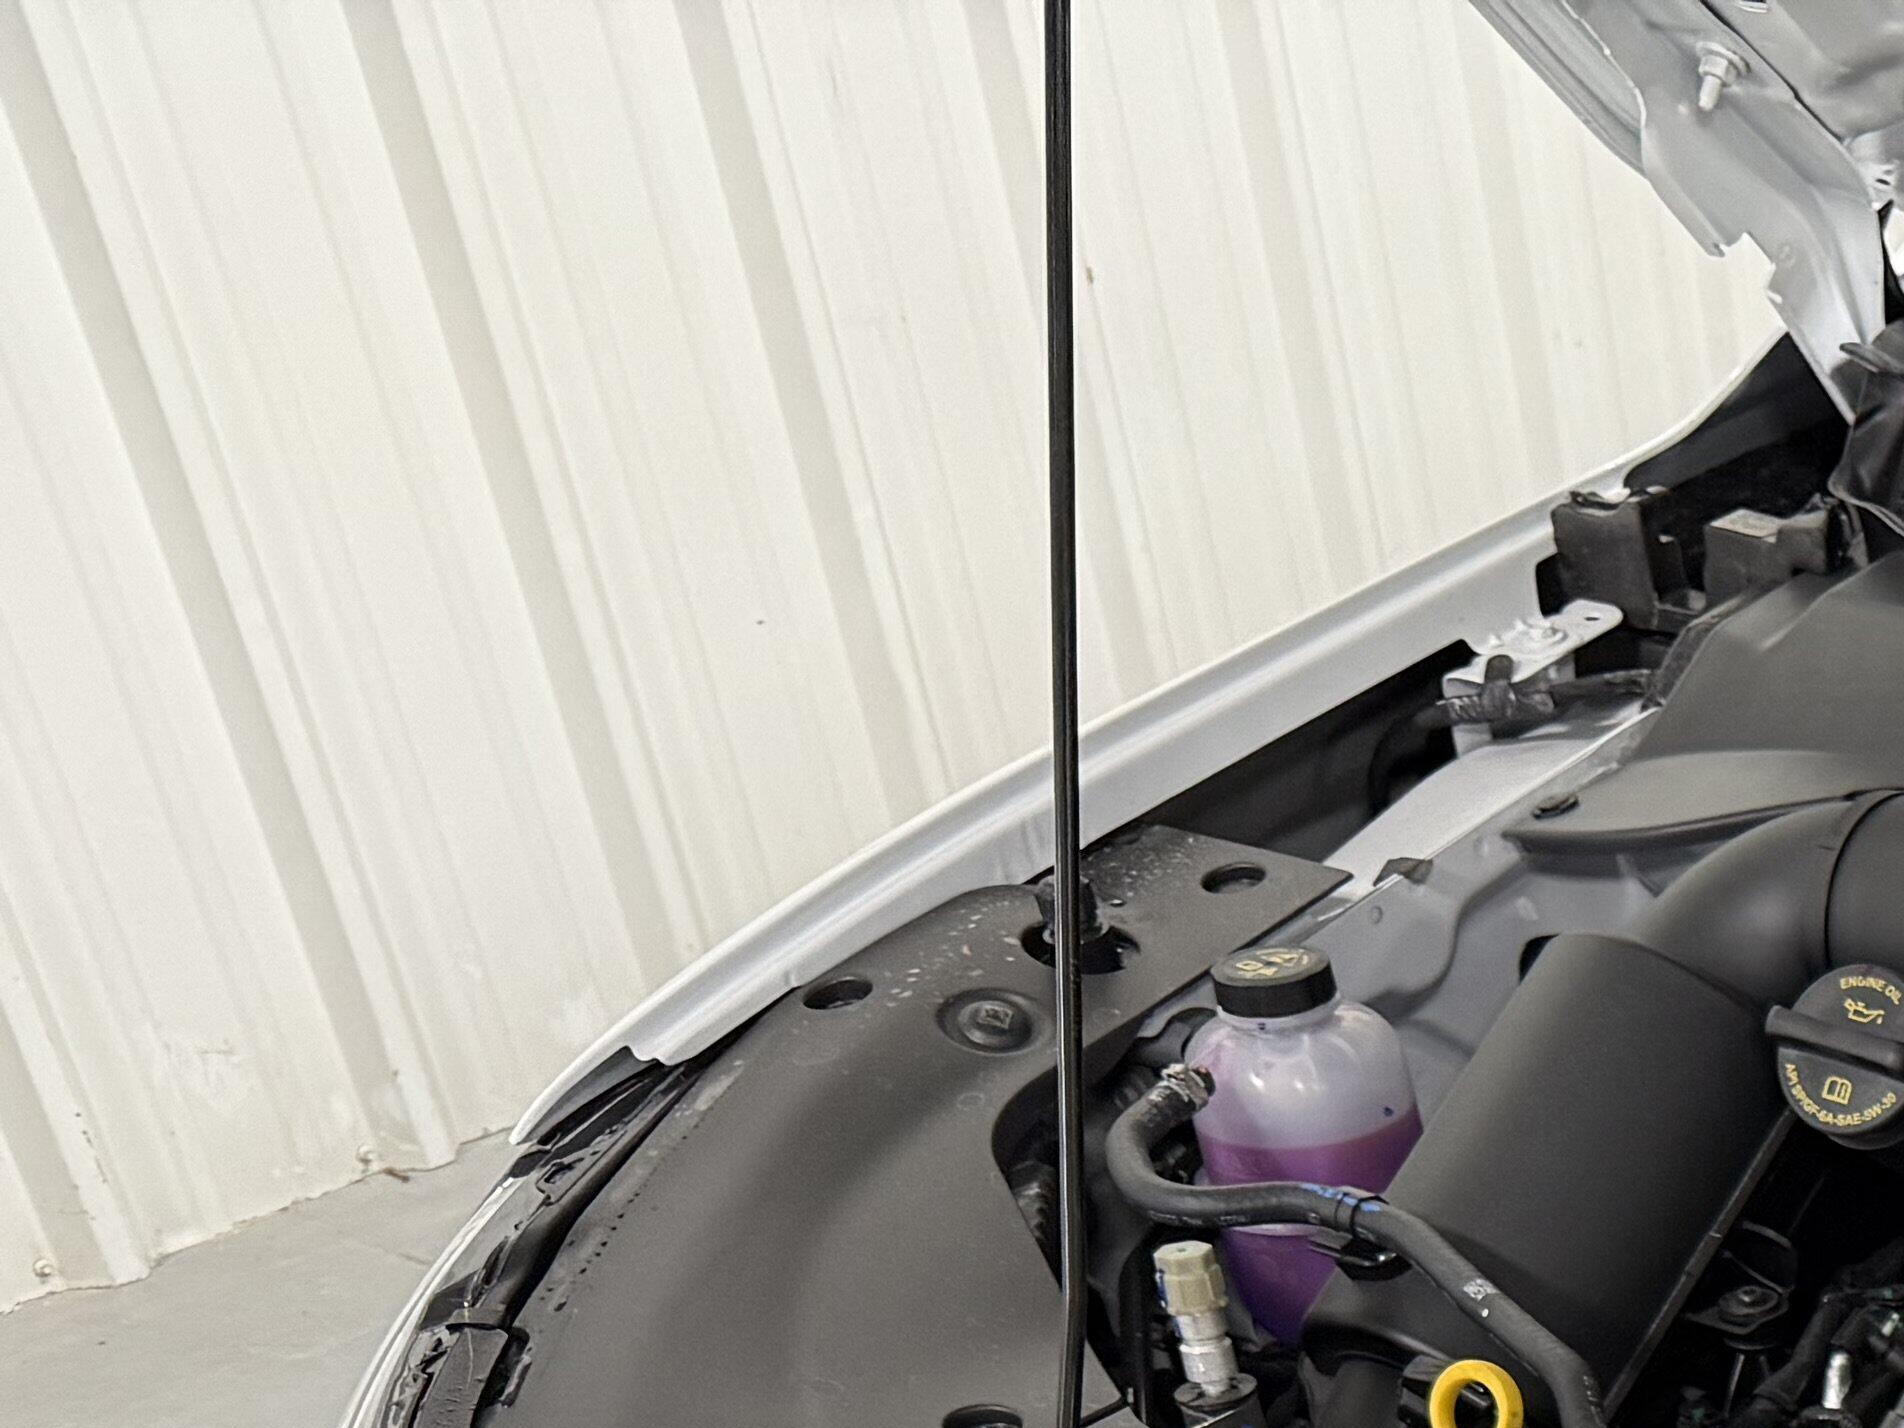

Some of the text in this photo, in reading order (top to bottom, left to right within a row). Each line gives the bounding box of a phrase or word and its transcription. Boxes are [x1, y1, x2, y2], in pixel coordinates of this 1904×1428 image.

[1839, 976, 1903, 1005] ENGINE OIL
[1784, 1063, 1798, 1086] API
